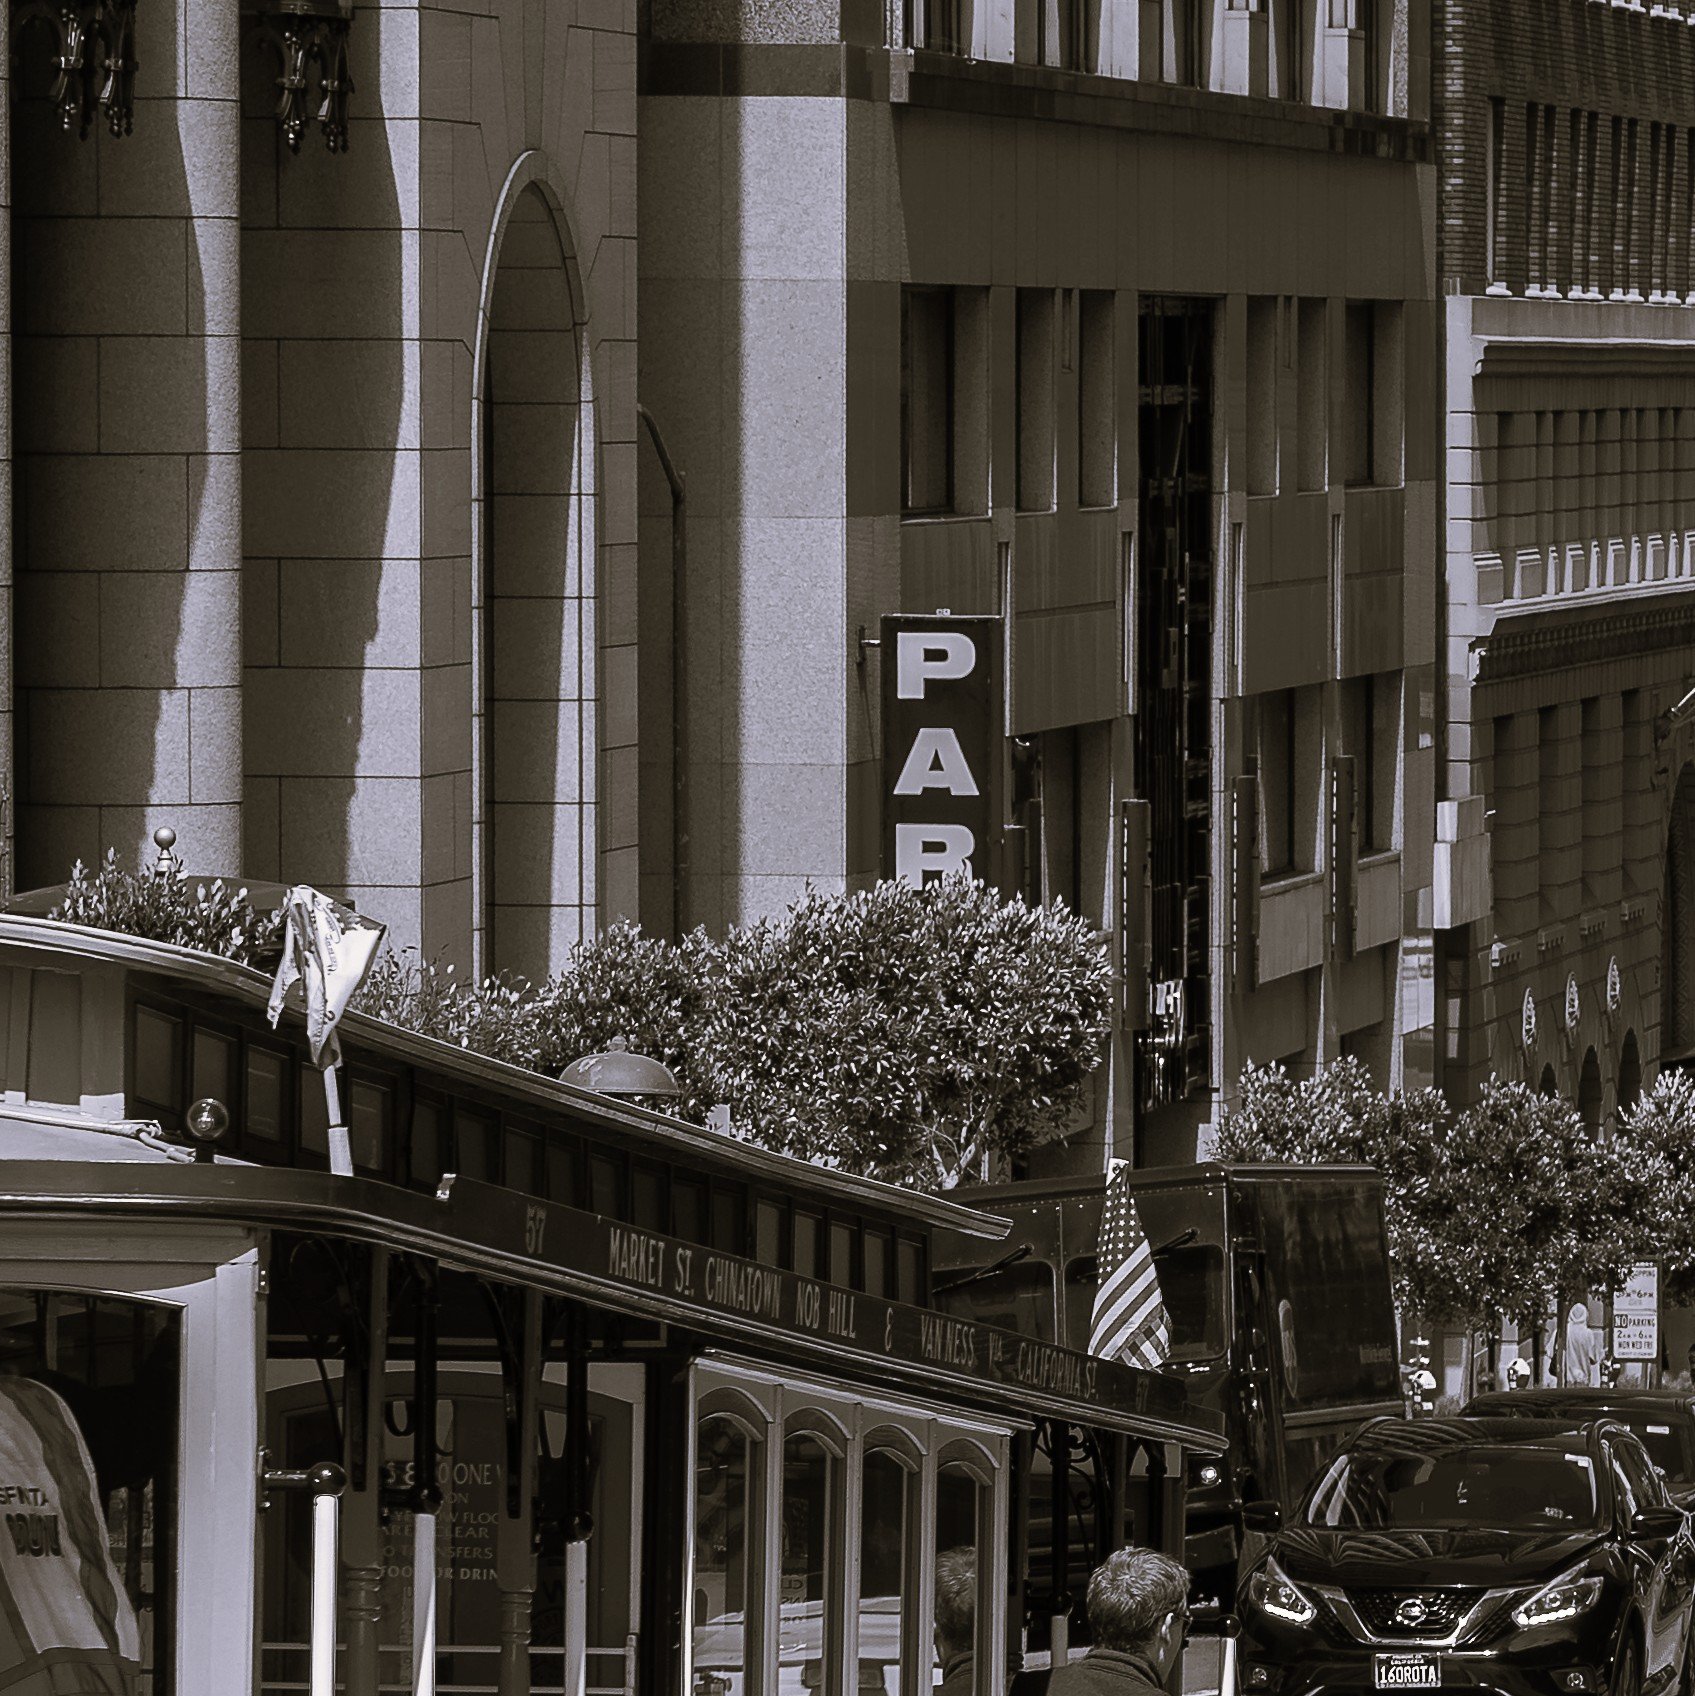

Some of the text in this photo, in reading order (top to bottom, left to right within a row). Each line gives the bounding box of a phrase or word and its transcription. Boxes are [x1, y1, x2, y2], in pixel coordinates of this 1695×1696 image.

[525, 1203, 547, 1255] 57
[608, 1226, 666, 1288] MARKET
[704, 1256, 783, 1320] CHINATOWN
[795, 1280, 821, 1330] NOB
[828, 1290, 857, 1340] HILL
[884, 1306, 894, 1352] &
[1017, 1341, 1081, 1396] CALIFORNIA
[1615, 1314, 1655, 1328] NO PARKING
[453, 1462, 494, 1486] ONE
[462, 1511, 499, 1525] FLOO
[459, 1567, 500, 1581] DRIN
